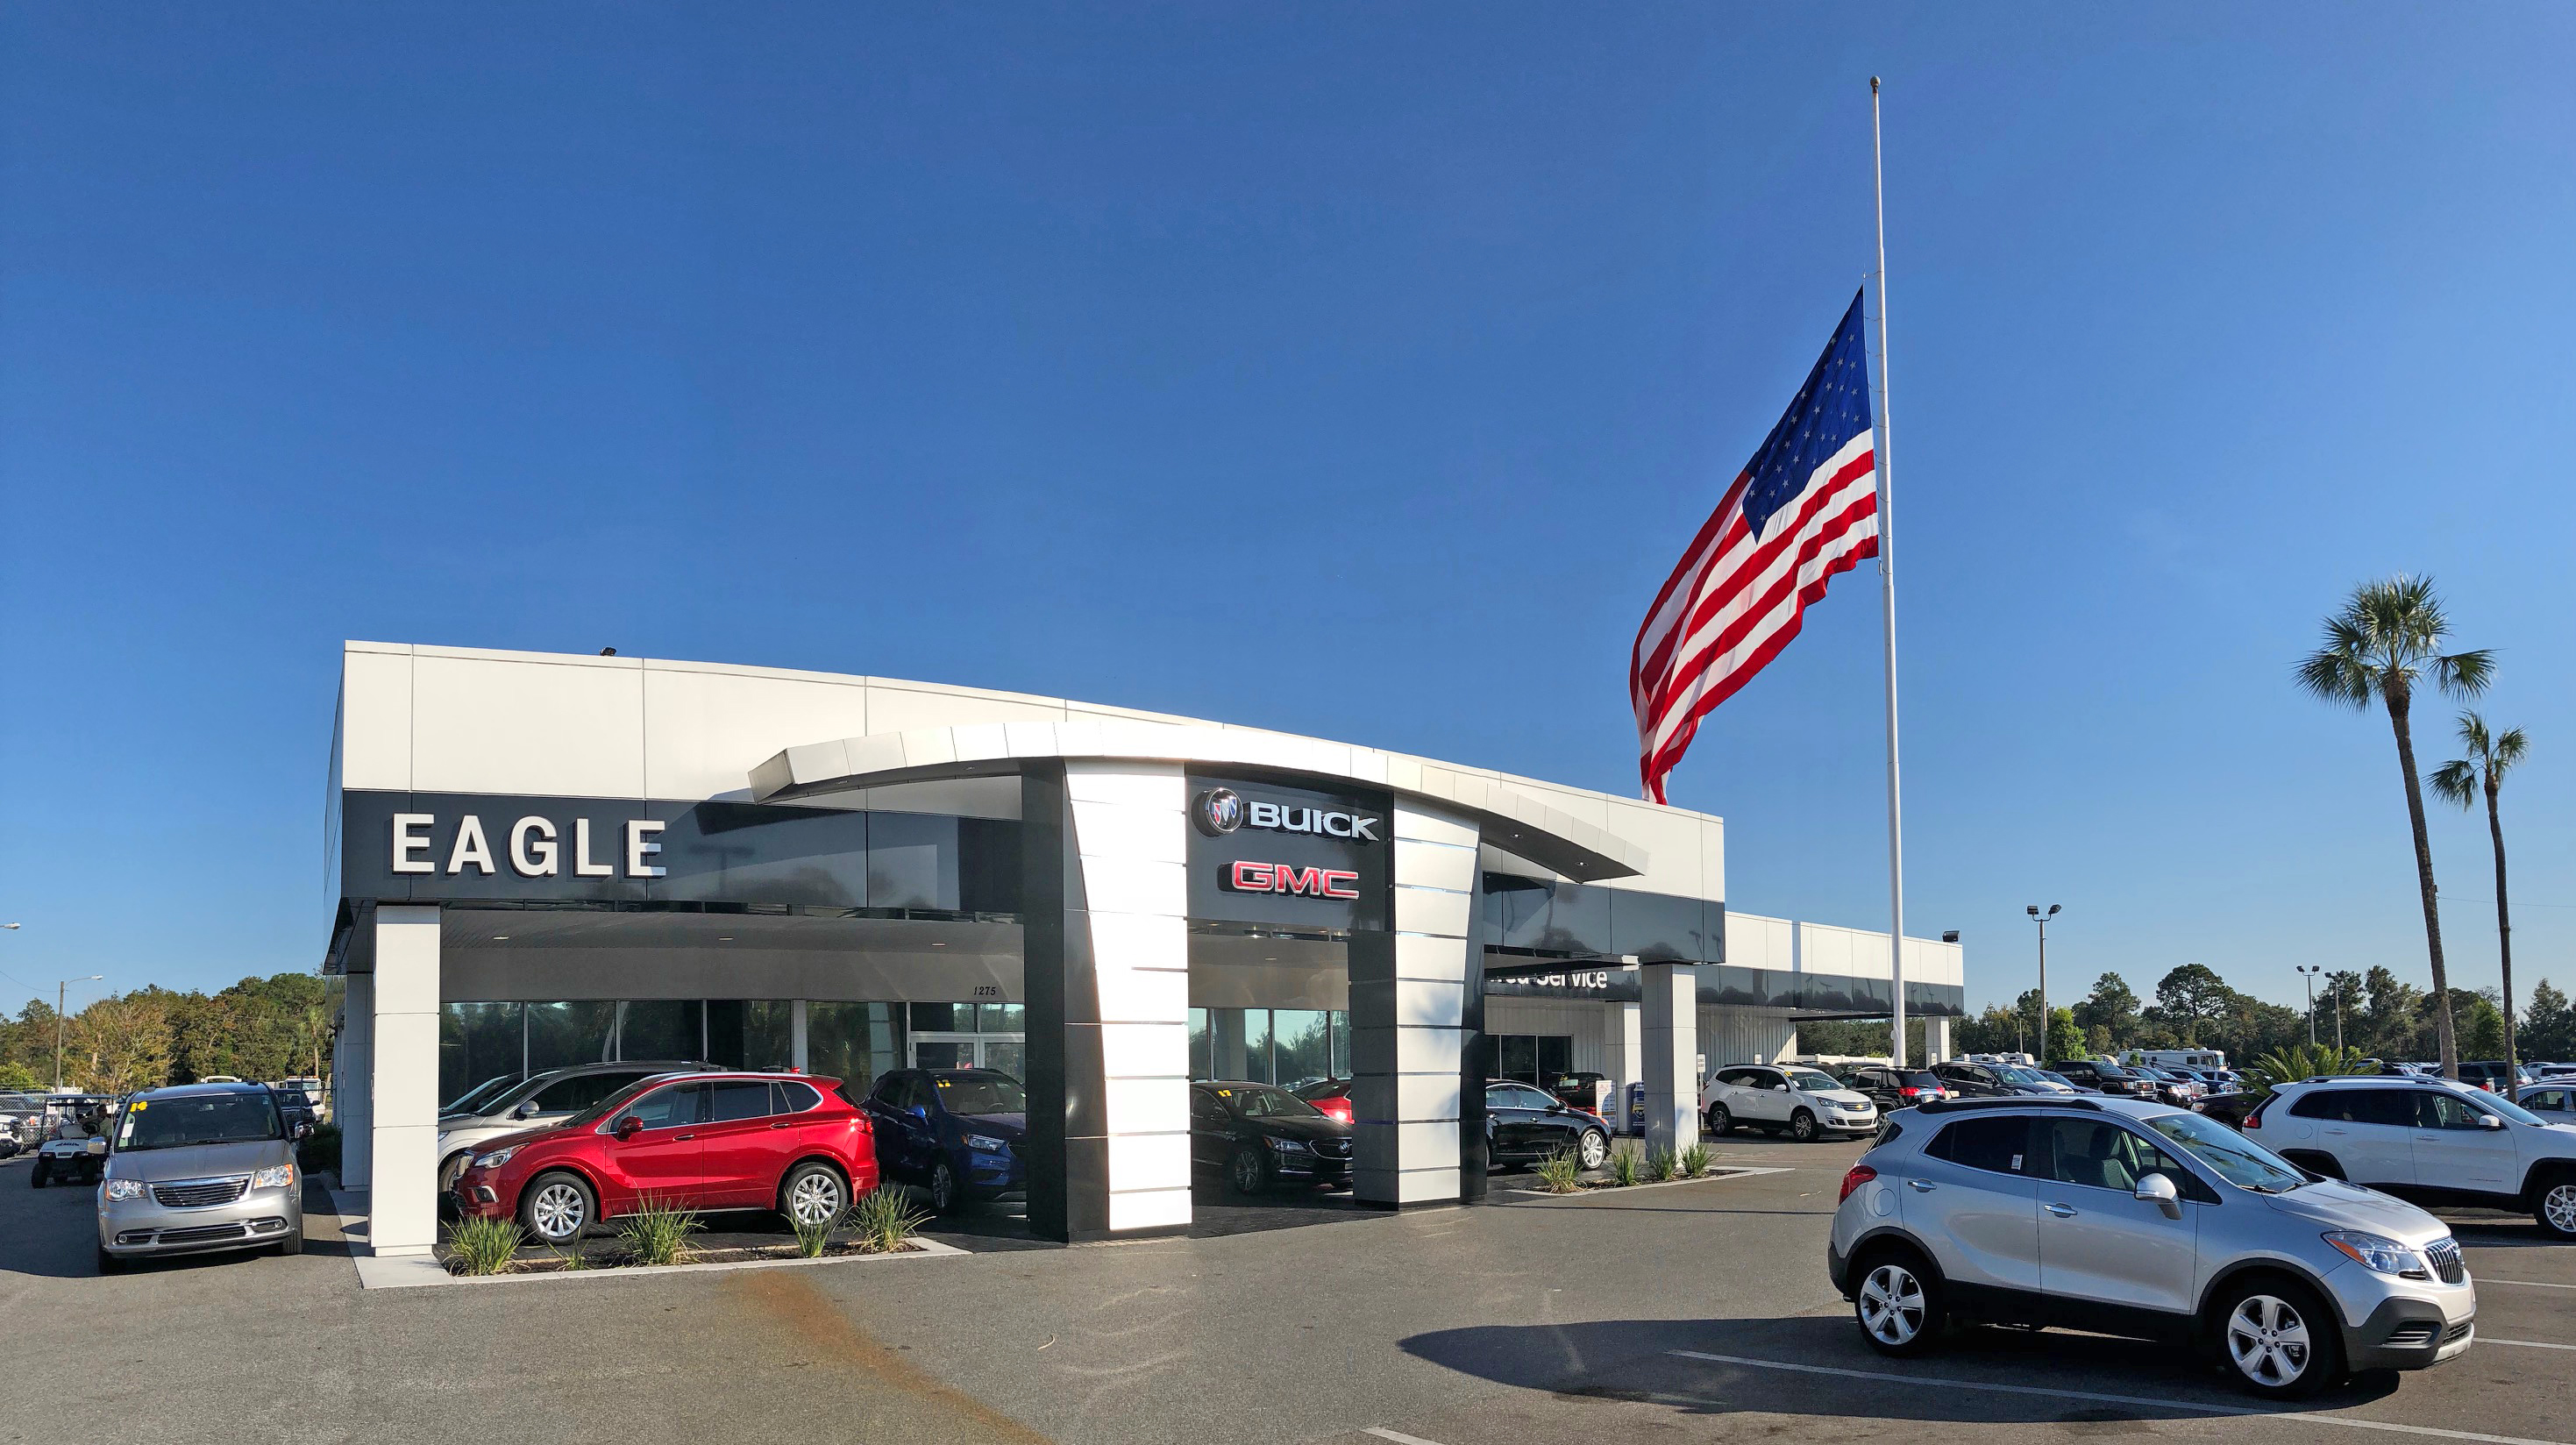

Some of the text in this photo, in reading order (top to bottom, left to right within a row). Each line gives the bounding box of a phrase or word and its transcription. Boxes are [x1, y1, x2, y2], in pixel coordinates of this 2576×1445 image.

[1250, 801, 1379, 841] BUICK
[392, 813, 666, 876] EAGLE
[1232, 860, 1359, 900] GMC
[973, 986, 996, 996] 1275
